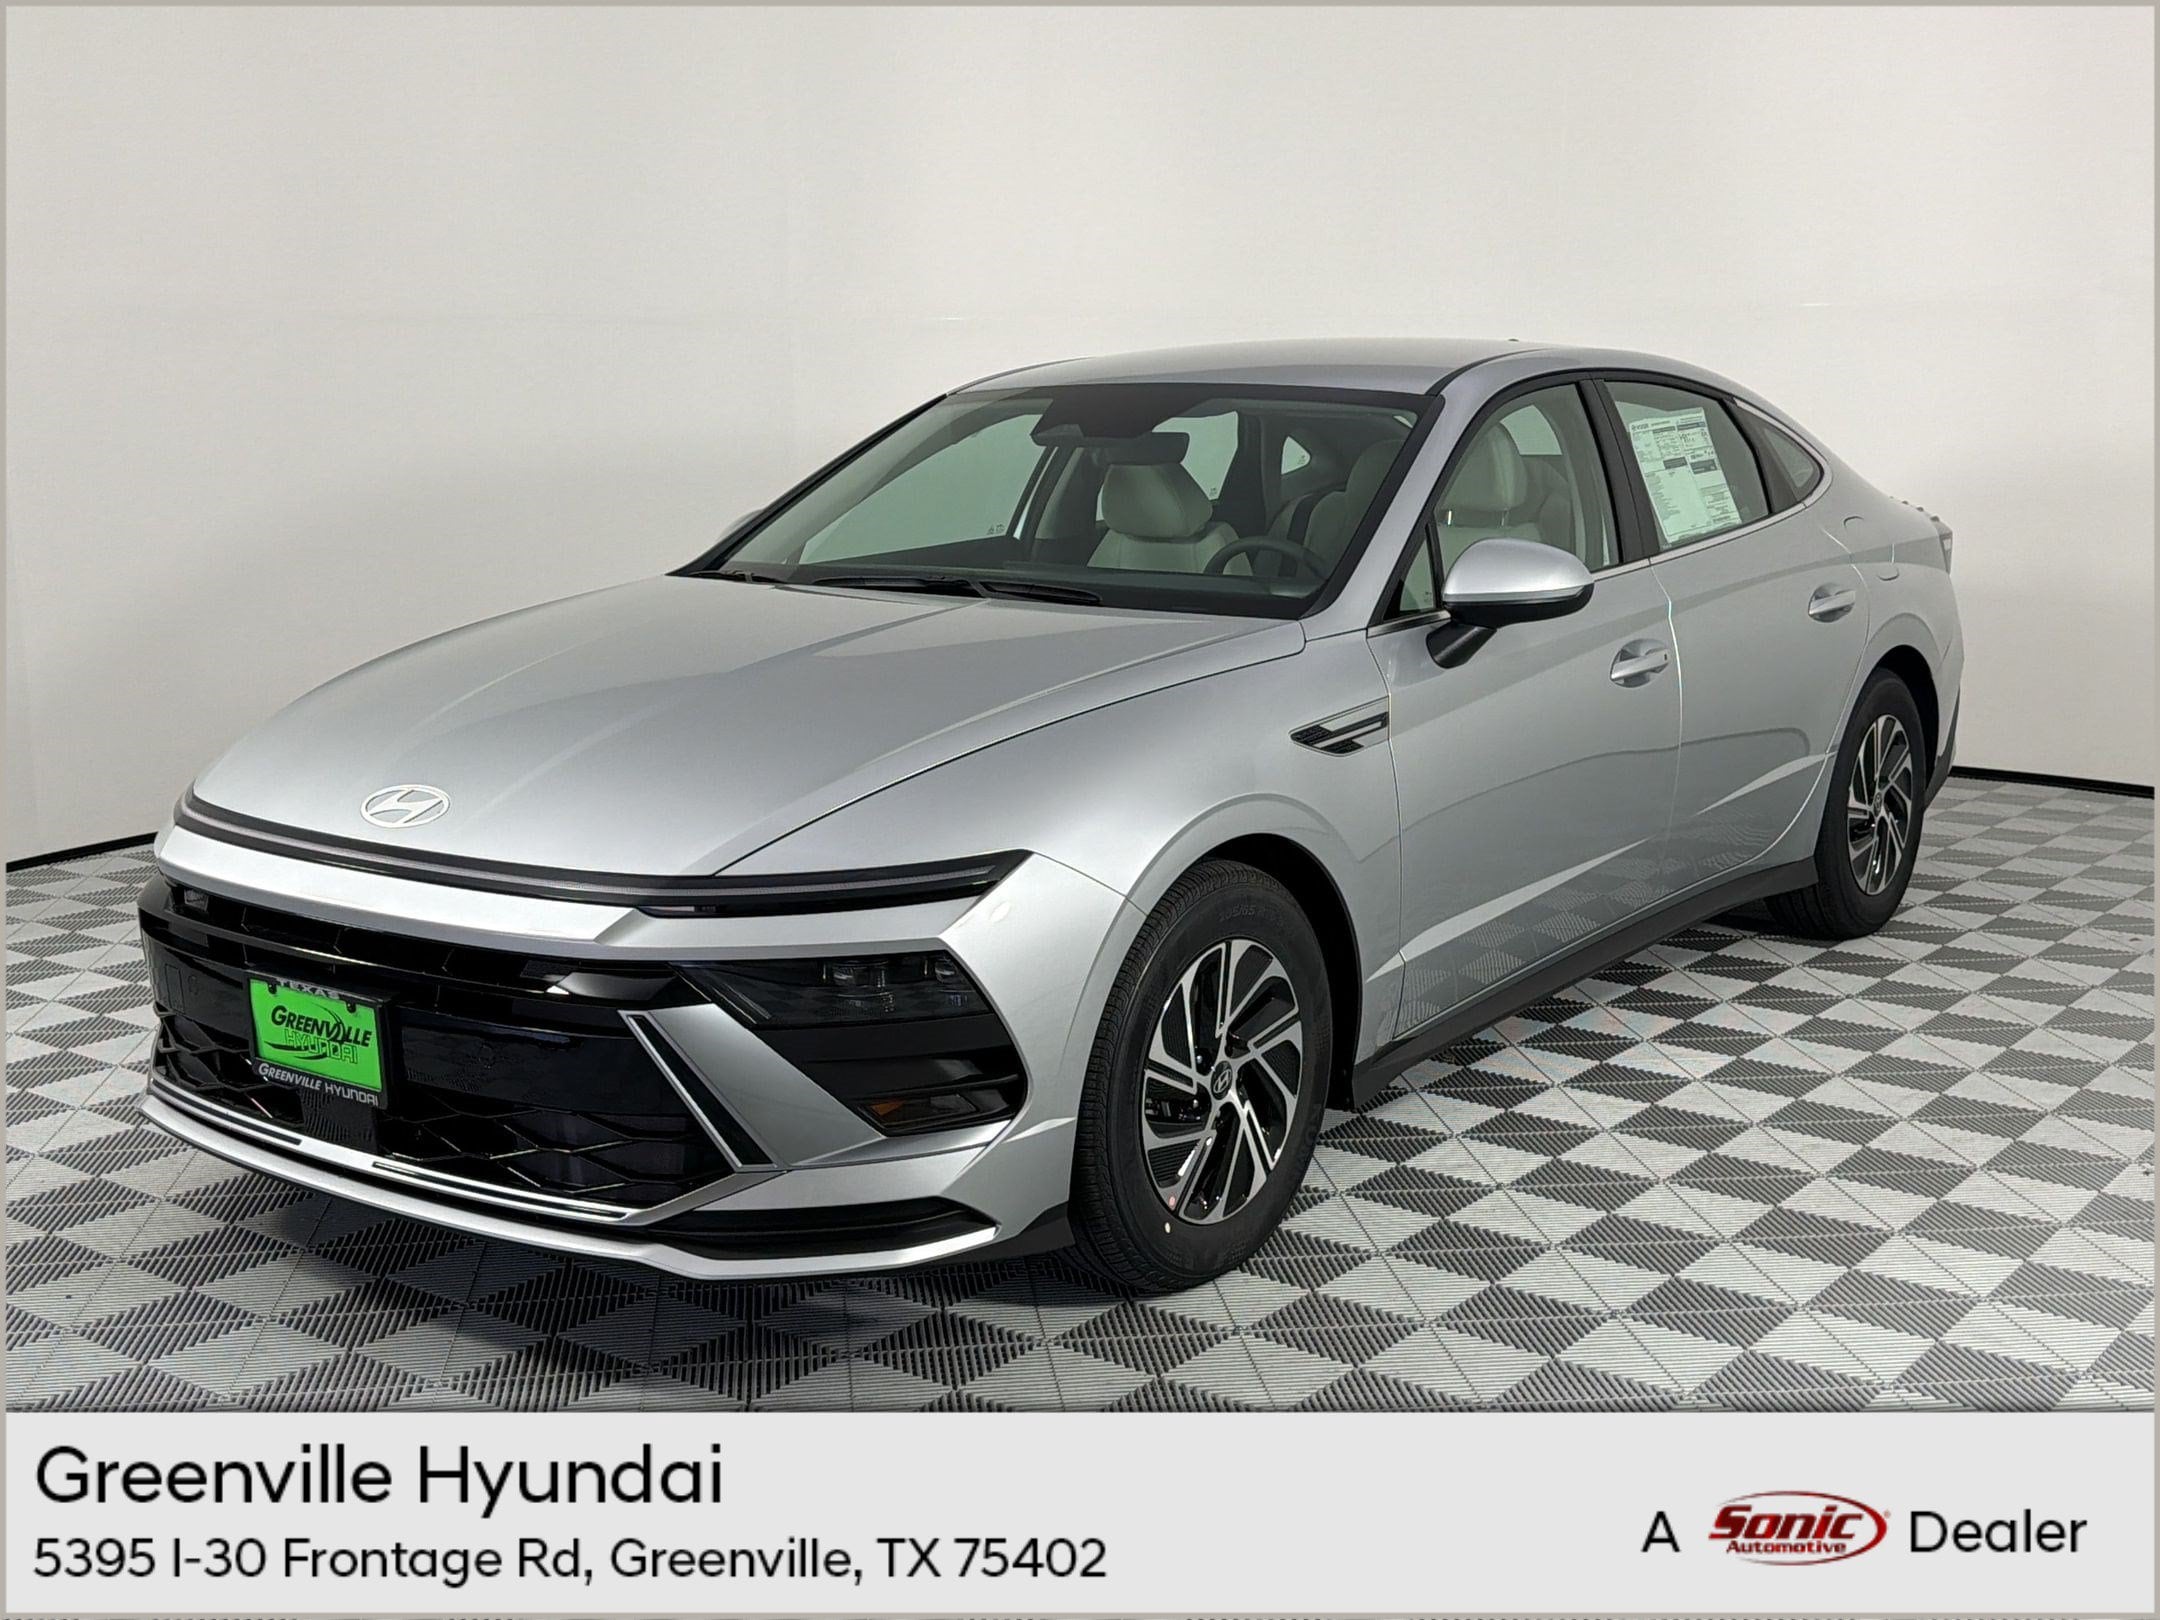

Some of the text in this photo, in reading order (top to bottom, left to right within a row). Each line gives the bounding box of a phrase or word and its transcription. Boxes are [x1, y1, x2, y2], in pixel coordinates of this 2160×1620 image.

[276, 977, 340, 1000] TEXAS
[271, 1005, 372, 1047] GREENVILLE
[284, 1028, 358, 1065] HYUNDAI
[258, 1062, 379, 1107] GREENVILLE HYUNDAI
